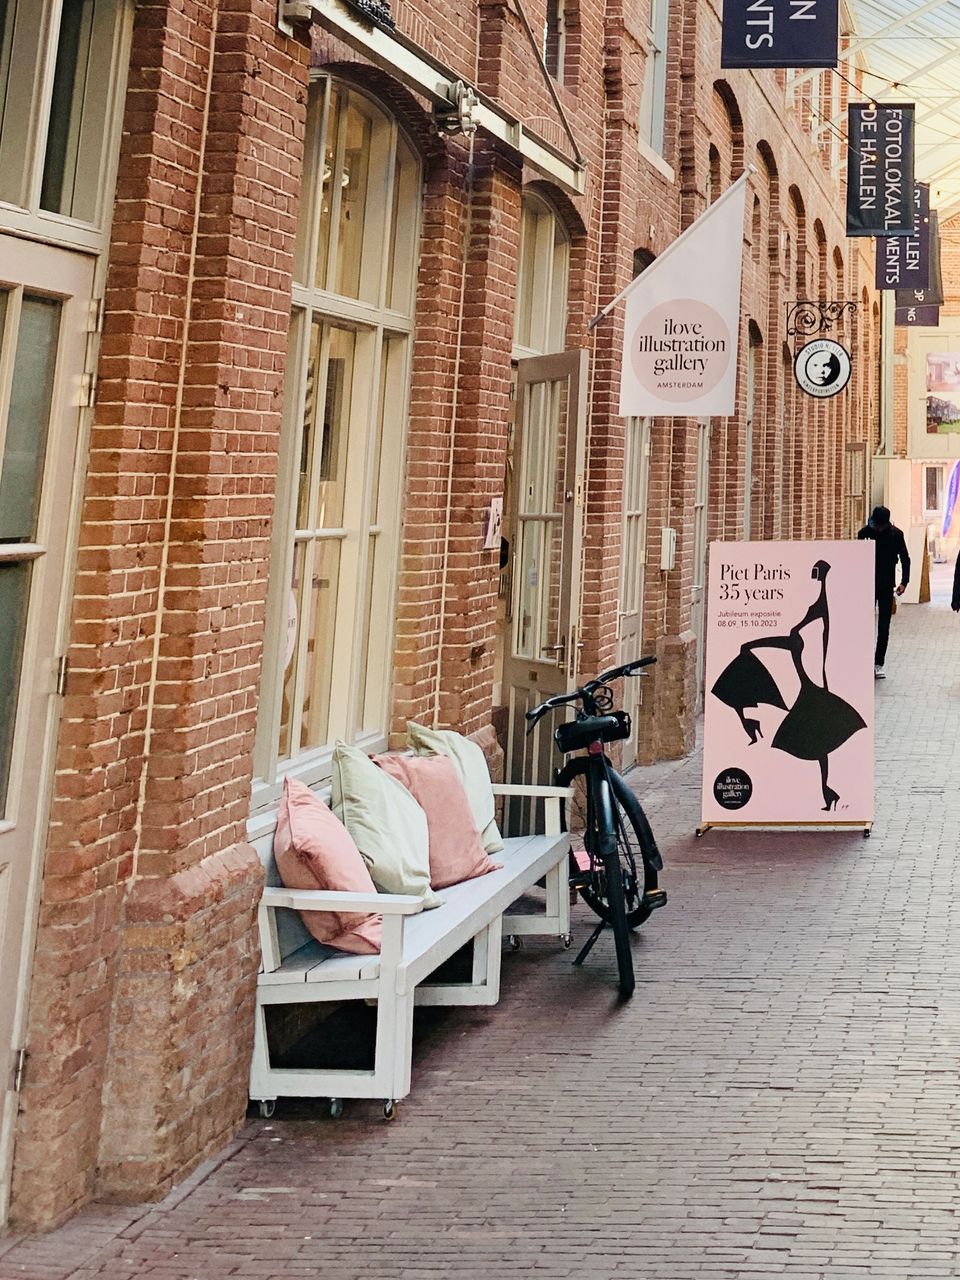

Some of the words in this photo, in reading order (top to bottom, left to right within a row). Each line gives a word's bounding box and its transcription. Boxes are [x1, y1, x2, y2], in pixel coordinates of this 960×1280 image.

[860, 109, 877, 133] DE
[859, 138, 877, 210] HALLEN
[884, 109, 903, 231] FOTOLOKAAL
[639, 335, 726, 352] illustration
[653, 353, 709, 376] gallery
[720, 563, 749, 581] Piet
[754, 563, 791, 581] Paris
[719, 583, 740, 601] 35
[744, 588, 784, 606] years
[717, 610, 749, 618] Jubileum
[750, 610, 781, 619] expositie
